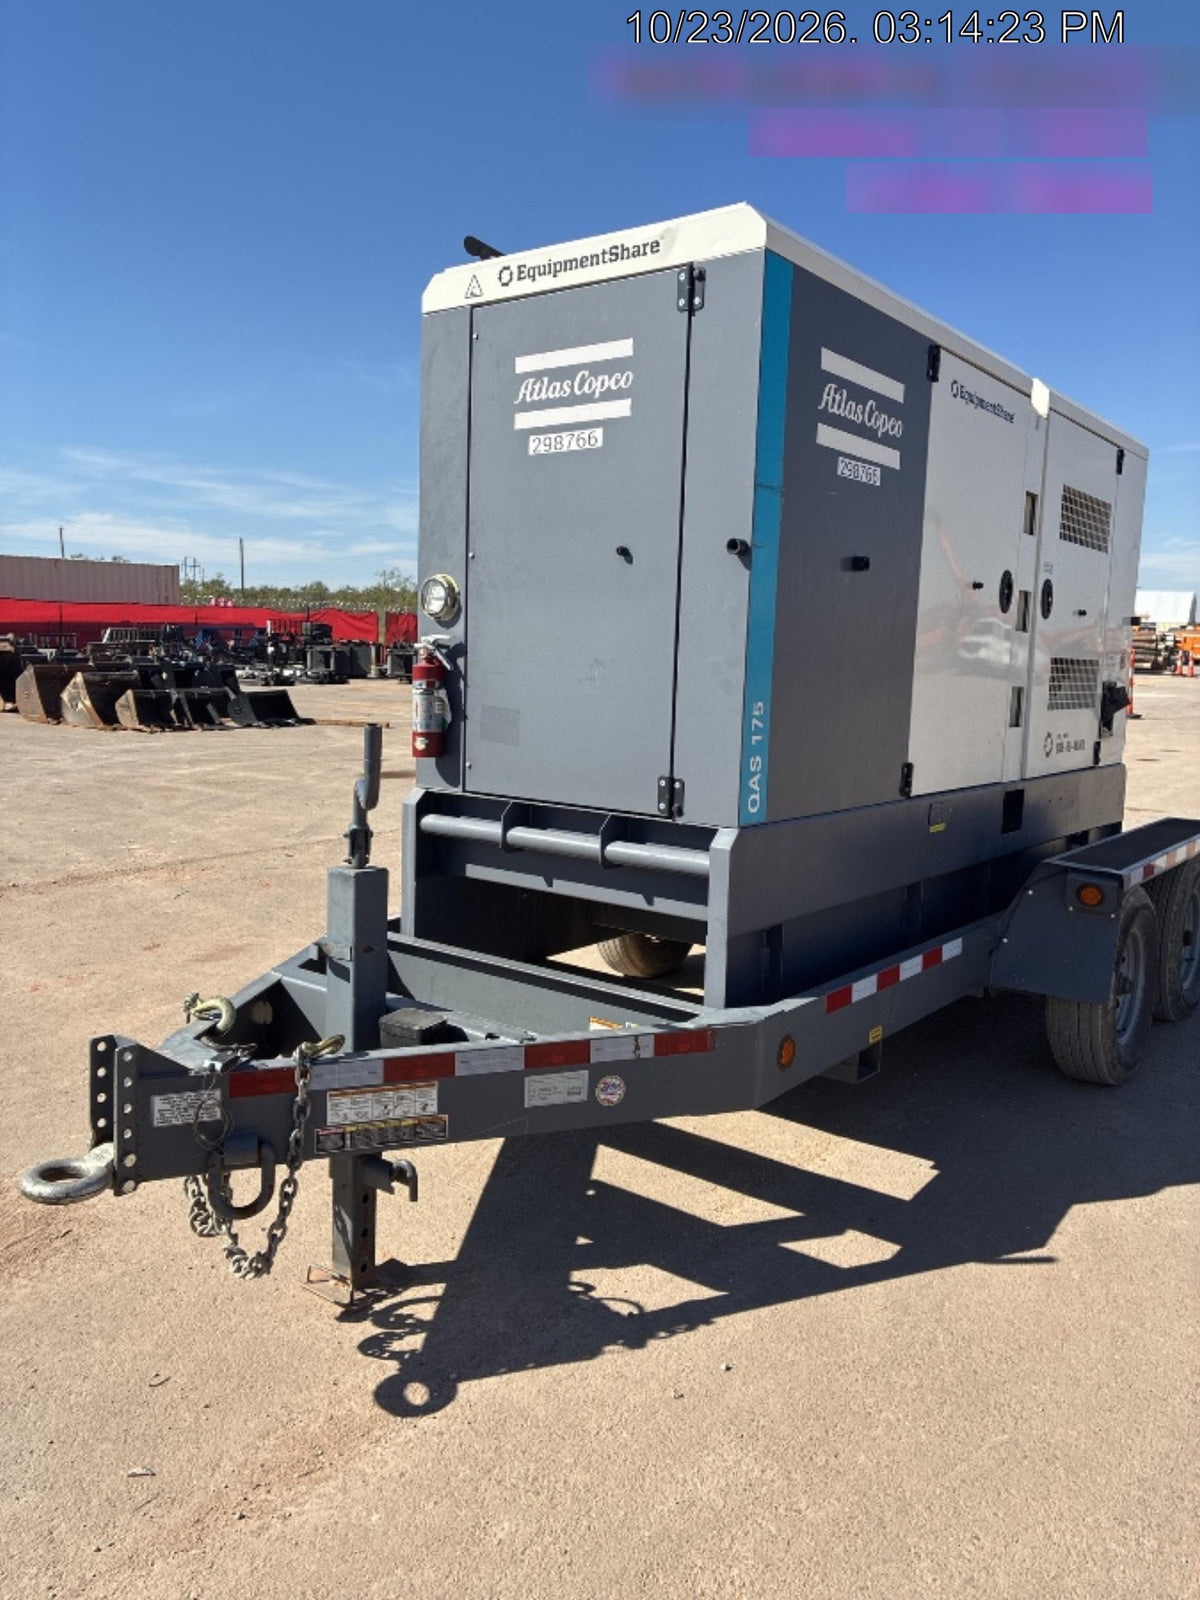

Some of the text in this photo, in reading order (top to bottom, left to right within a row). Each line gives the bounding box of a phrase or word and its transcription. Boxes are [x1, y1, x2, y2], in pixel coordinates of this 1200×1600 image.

[516, 238, 661, 283] EquipmentShare
[513, 369, 633, 404] Atlas Copco
[817, 383, 903, 438] Atlas Copco
[531, 429, 599, 454] 298766
[747, 701, 764, 813] QAS 175
